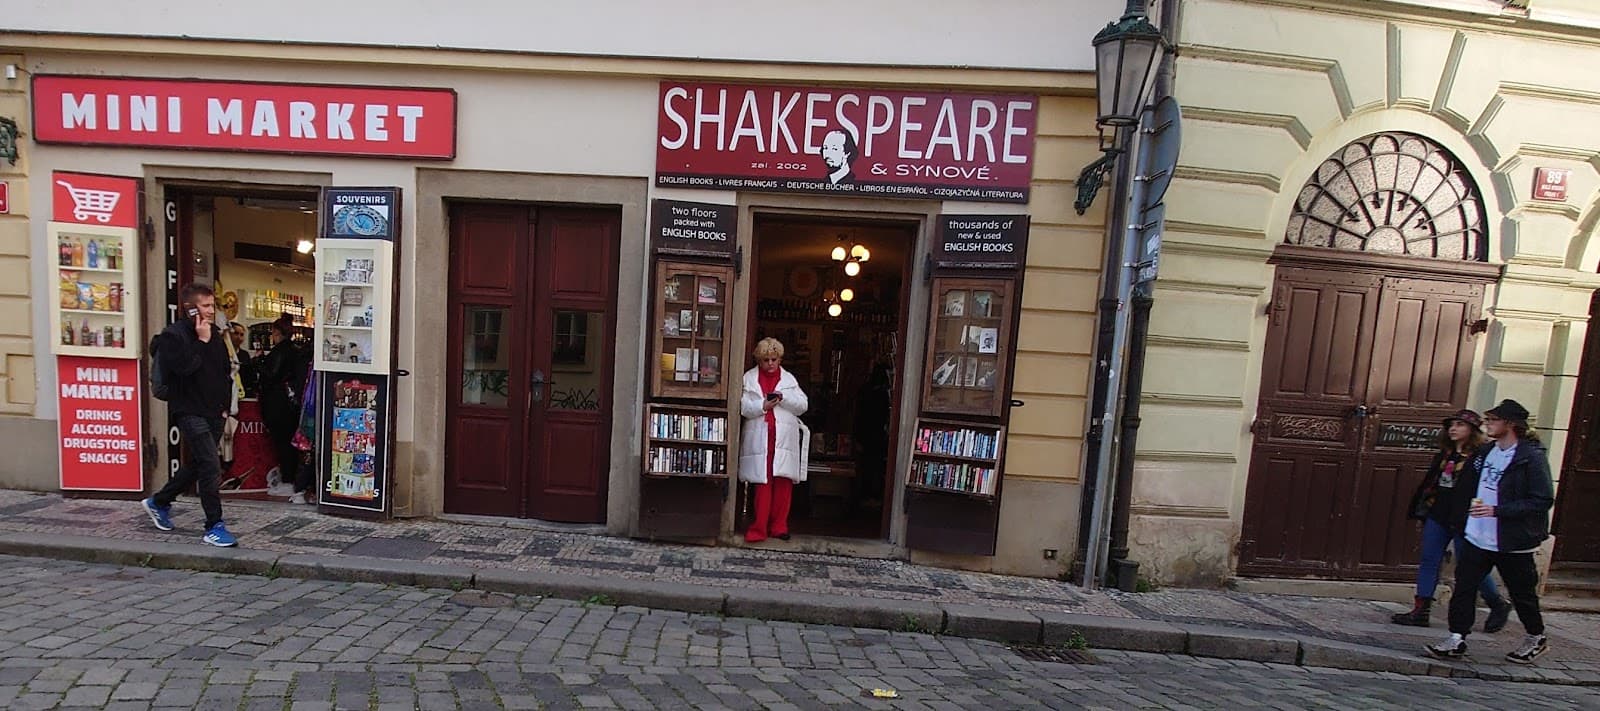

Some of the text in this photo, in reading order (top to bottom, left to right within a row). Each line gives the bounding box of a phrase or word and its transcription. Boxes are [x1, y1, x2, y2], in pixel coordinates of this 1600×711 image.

[61, 92, 424, 142] MINI MARKET
[661, 86, 1033, 164] SHAKESPEARE
[776, 162, 807, 171] 2002
[870, 163, 992, 180] & SYNOVÉ
[1547, 170, 1562, 184] 89
[659, 176, 689, 185] ENGLISH
[689, 177, 714, 186] BOOKS
[719, 178, 743, 187] LIVRES
[744, 179, 778, 188] FRANÇAIS
[786, 181, 824, 190] DEUTSCHE
[859, 185, 885, 193] LIBROS
[886, 185, 897, 193] EN
[897, 185, 928, 195] ESPAÑOL
[981, 190, 1024, 199] LITERATURA
[336, 195, 386, 204] SOUVENIRS
[672, 206, 717, 218] two floors
[673, 218, 715, 228] packed with
[949, 220, 1013, 230] thousands of
[662, 227, 727, 241] ENGLISH BOOKS
[974, 231, 981, 240] &
[982, 232, 1002, 240] used
[944, 242, 1014, 253] ENGLISH BOOKS
[165, 201, 178, 325] GIFT
[76, 367, 118, 383] MINI
[61, 383, 134, 401] MARKET
[76, 408, 122, 421] DRINKS
[71, 422, 127, 436] ALCOHOL
[240, 421, 269, 434] MIN
[63, 437, 136, 450] DRUGSTORE
[79, 452, 128, 464] SNACKS
